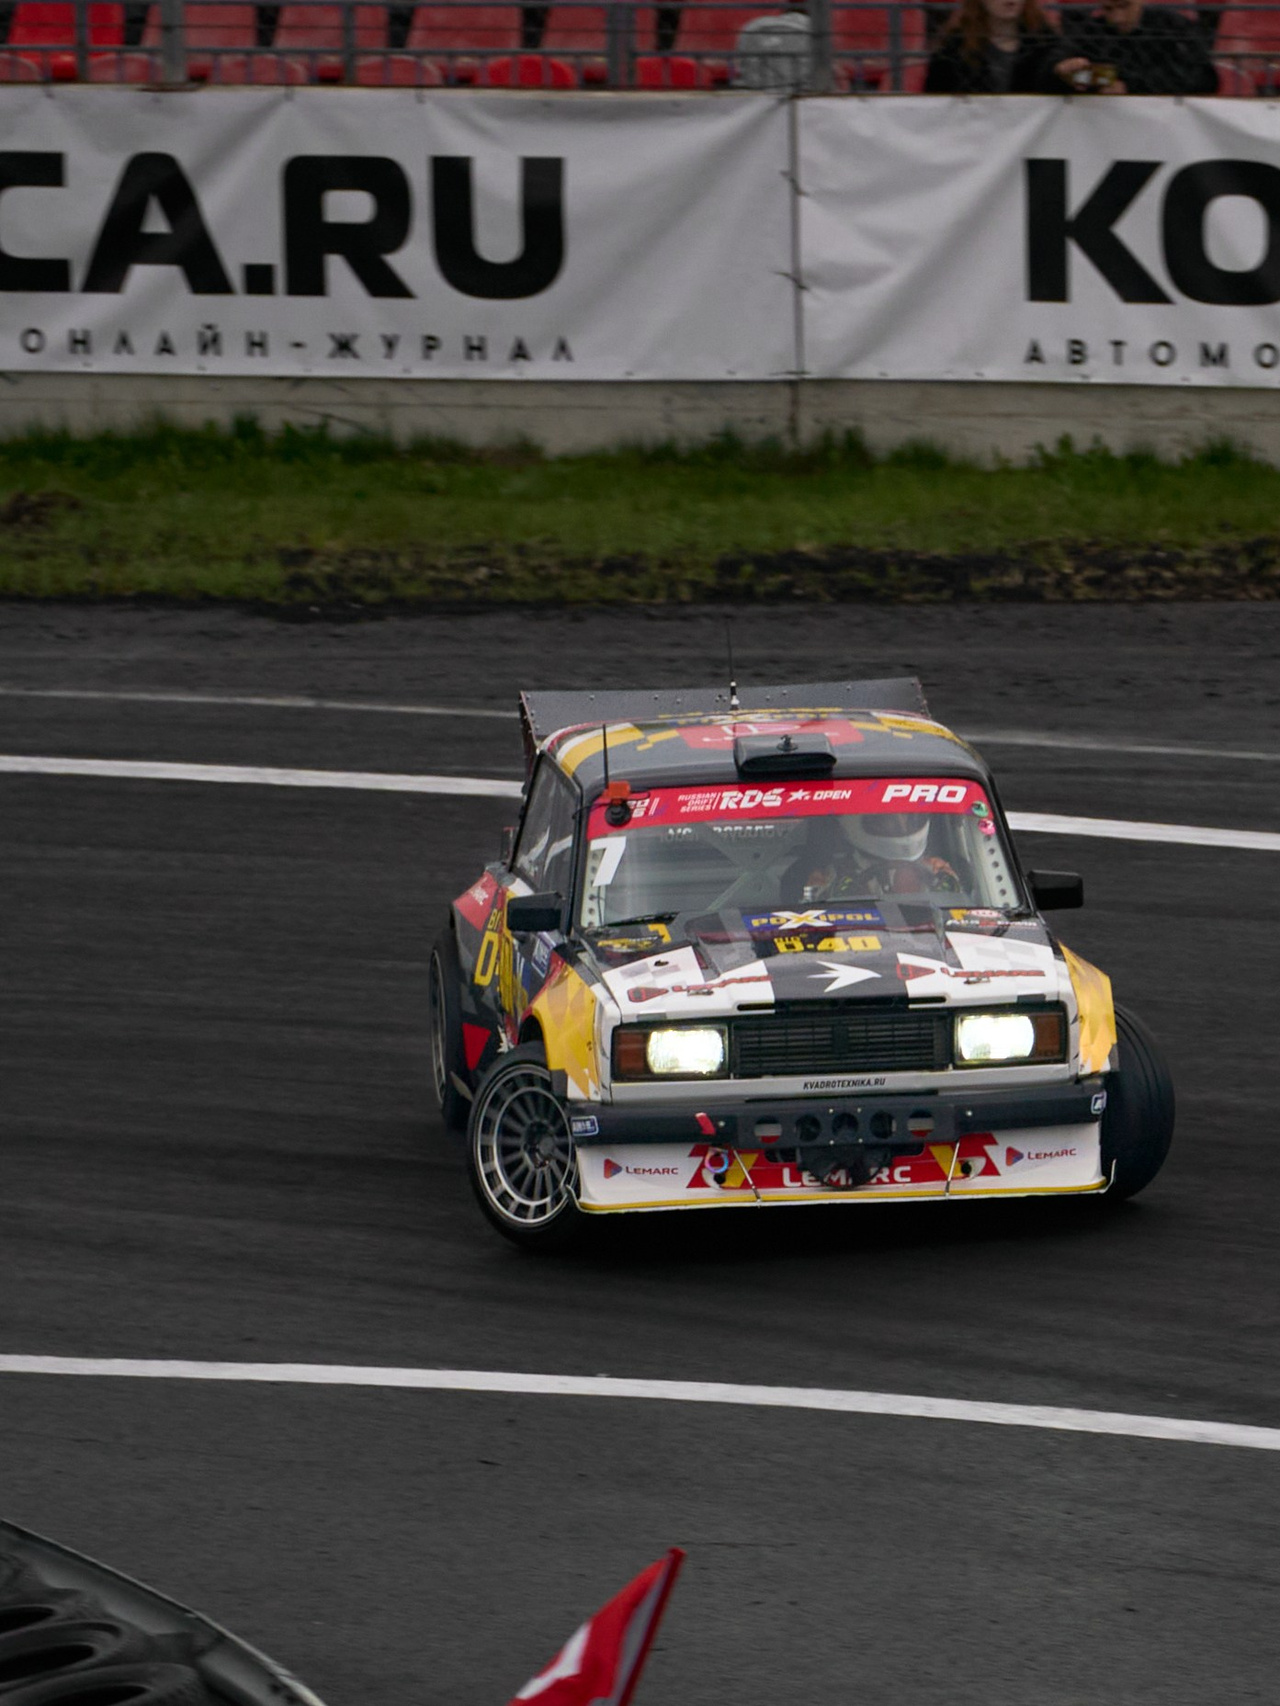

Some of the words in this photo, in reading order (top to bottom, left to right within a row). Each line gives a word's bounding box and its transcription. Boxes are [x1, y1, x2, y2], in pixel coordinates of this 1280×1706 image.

[20, 323, 575, 364] ОНЛАЙН-ЖУРНАЛ
[678, 792, 717, 802] RUSSIAN
[687, 799, 713, 807] DRIFT
[719, 788, 785, 810] RDS
[813, 789, 852, 801] OPEN
[881, 784, 968, 803] PRO
[680, 805, 712, 813] SERIES
[589, 836, 627, 887] 7
[751, 909, 880, 930] POXIPOL
[1027, 1148, 1077, 1160] LEMARC
[625, 1166, 679, 1175] LEMARC
